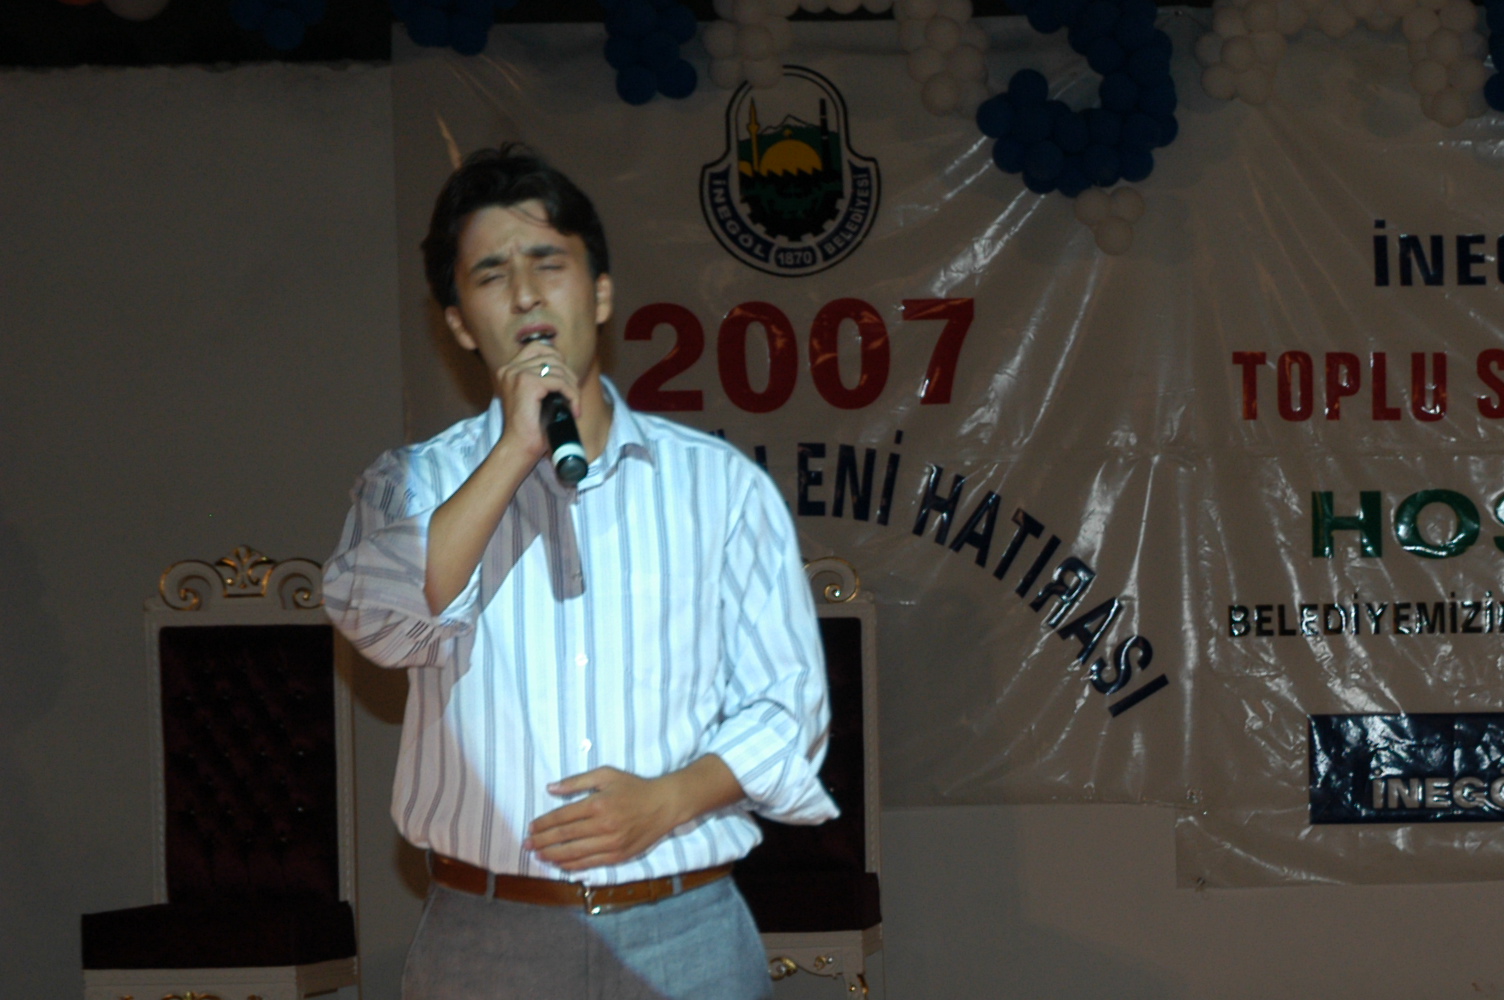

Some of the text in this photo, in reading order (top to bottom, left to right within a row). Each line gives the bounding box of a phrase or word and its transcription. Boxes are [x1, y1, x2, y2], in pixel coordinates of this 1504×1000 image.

[776, 251, 815, 265] 1870
[622, 297, 975, 413] 2007
[1231, 351, 1448, 422] TOPLU
